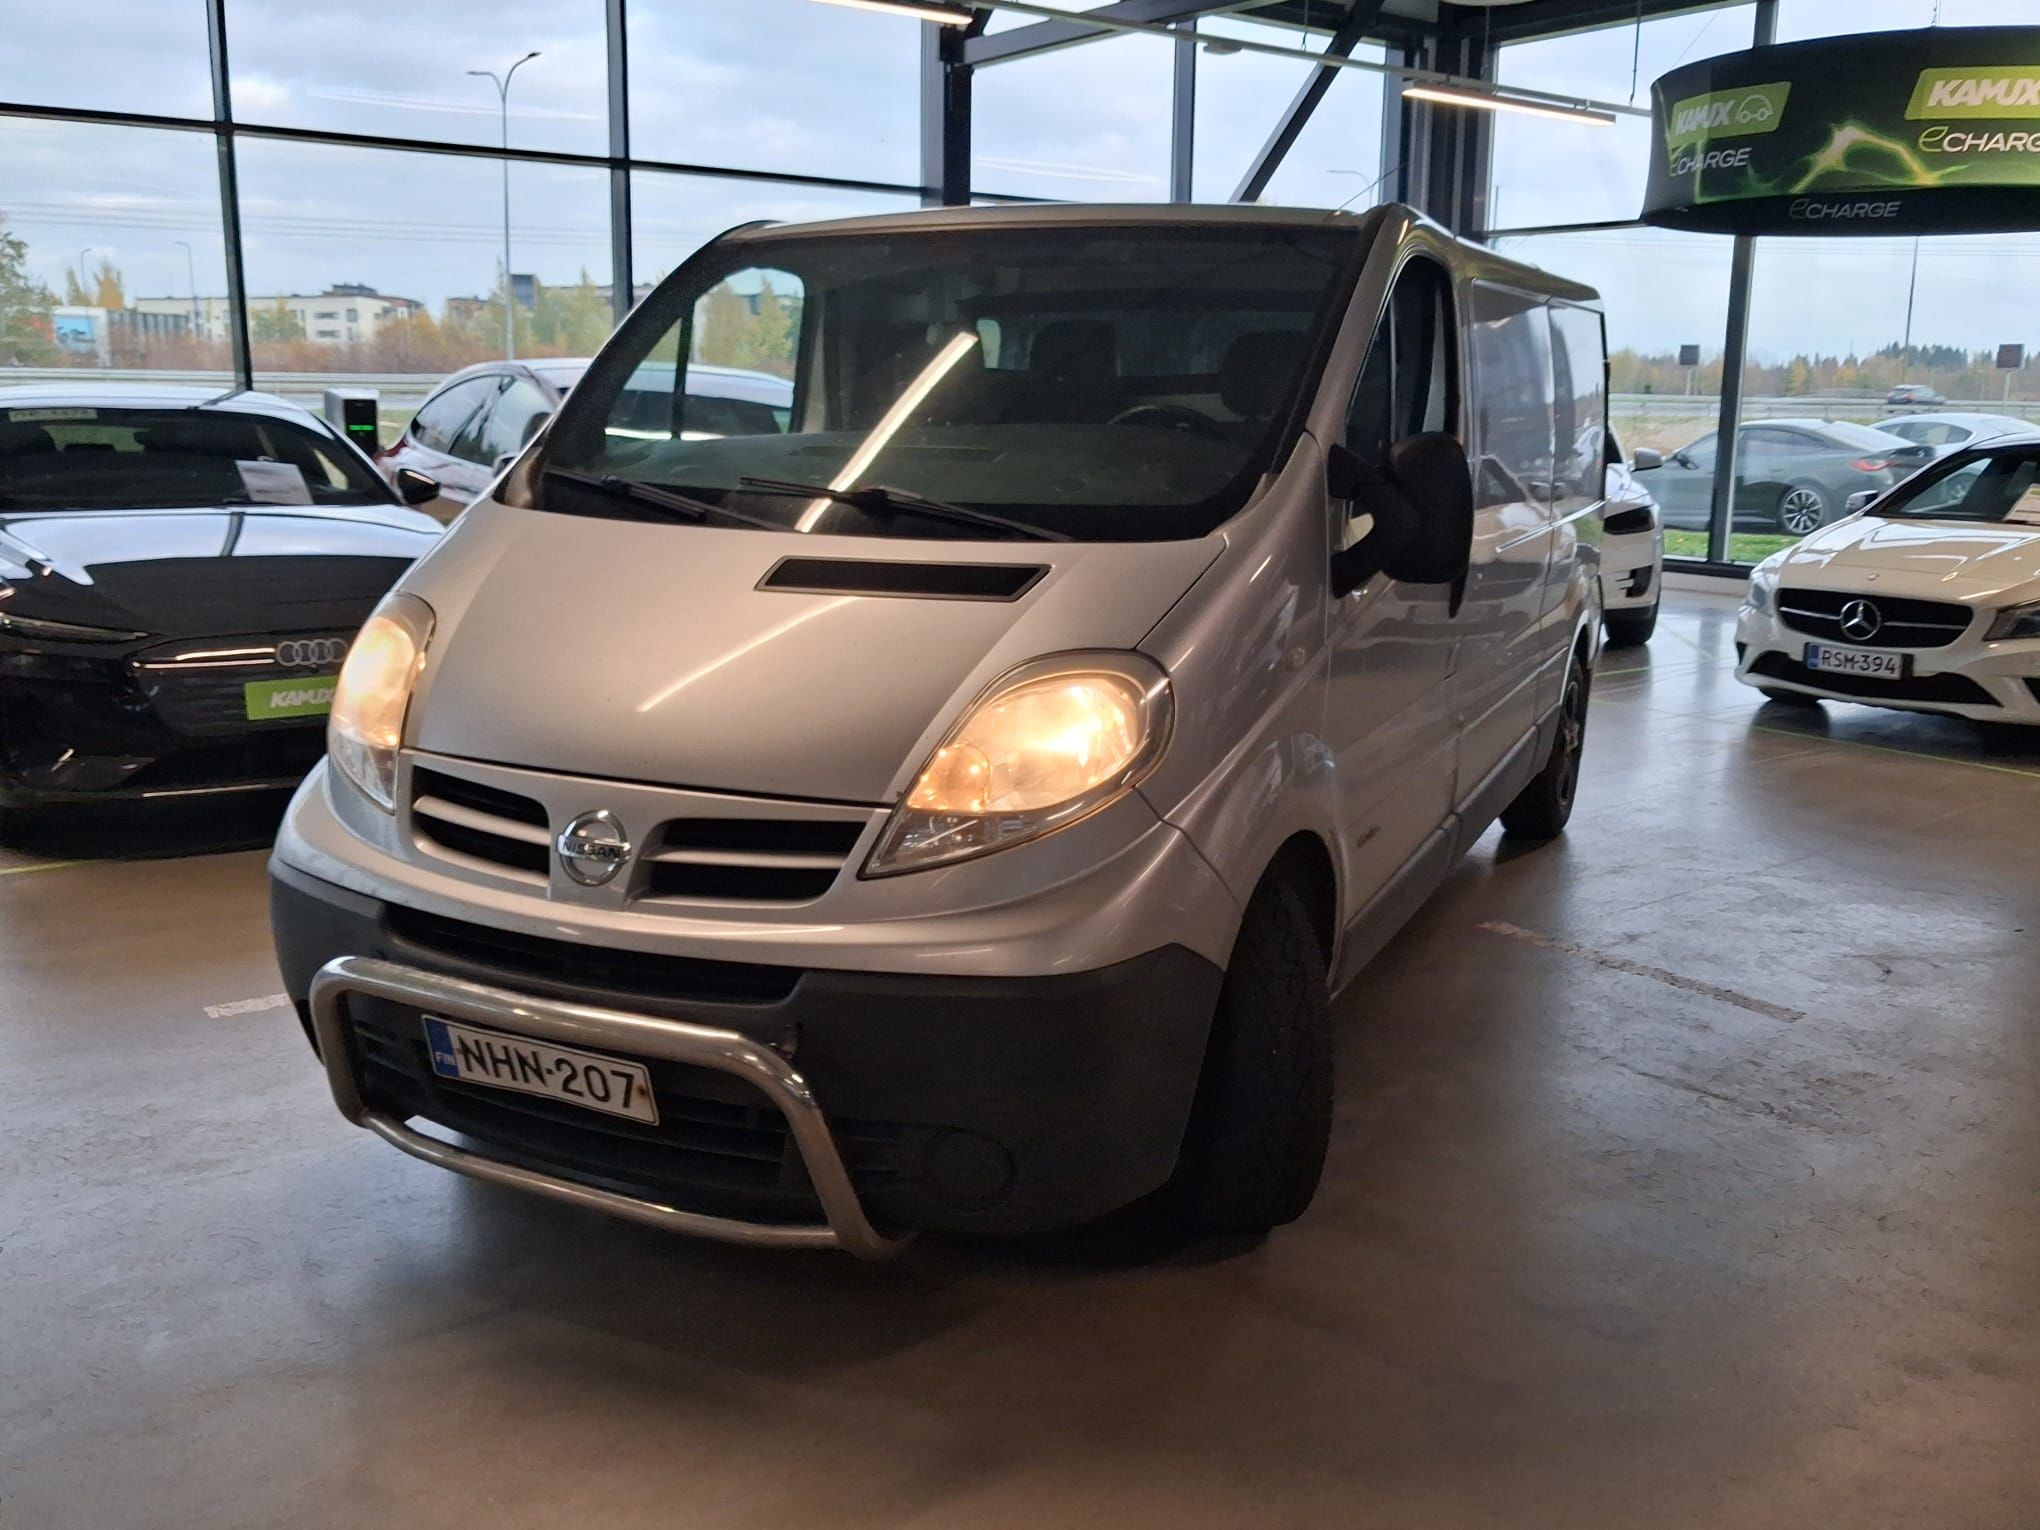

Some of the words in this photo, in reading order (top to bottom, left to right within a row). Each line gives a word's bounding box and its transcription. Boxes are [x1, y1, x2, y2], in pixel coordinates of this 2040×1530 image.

[1927, 78, 2040, 107] KAMUX
[1676, 101, 1736, 136] KAMUX
[1822, 650, 1897, 674] RSM-394
[457, 1035, 635, 1108] NHN-207
